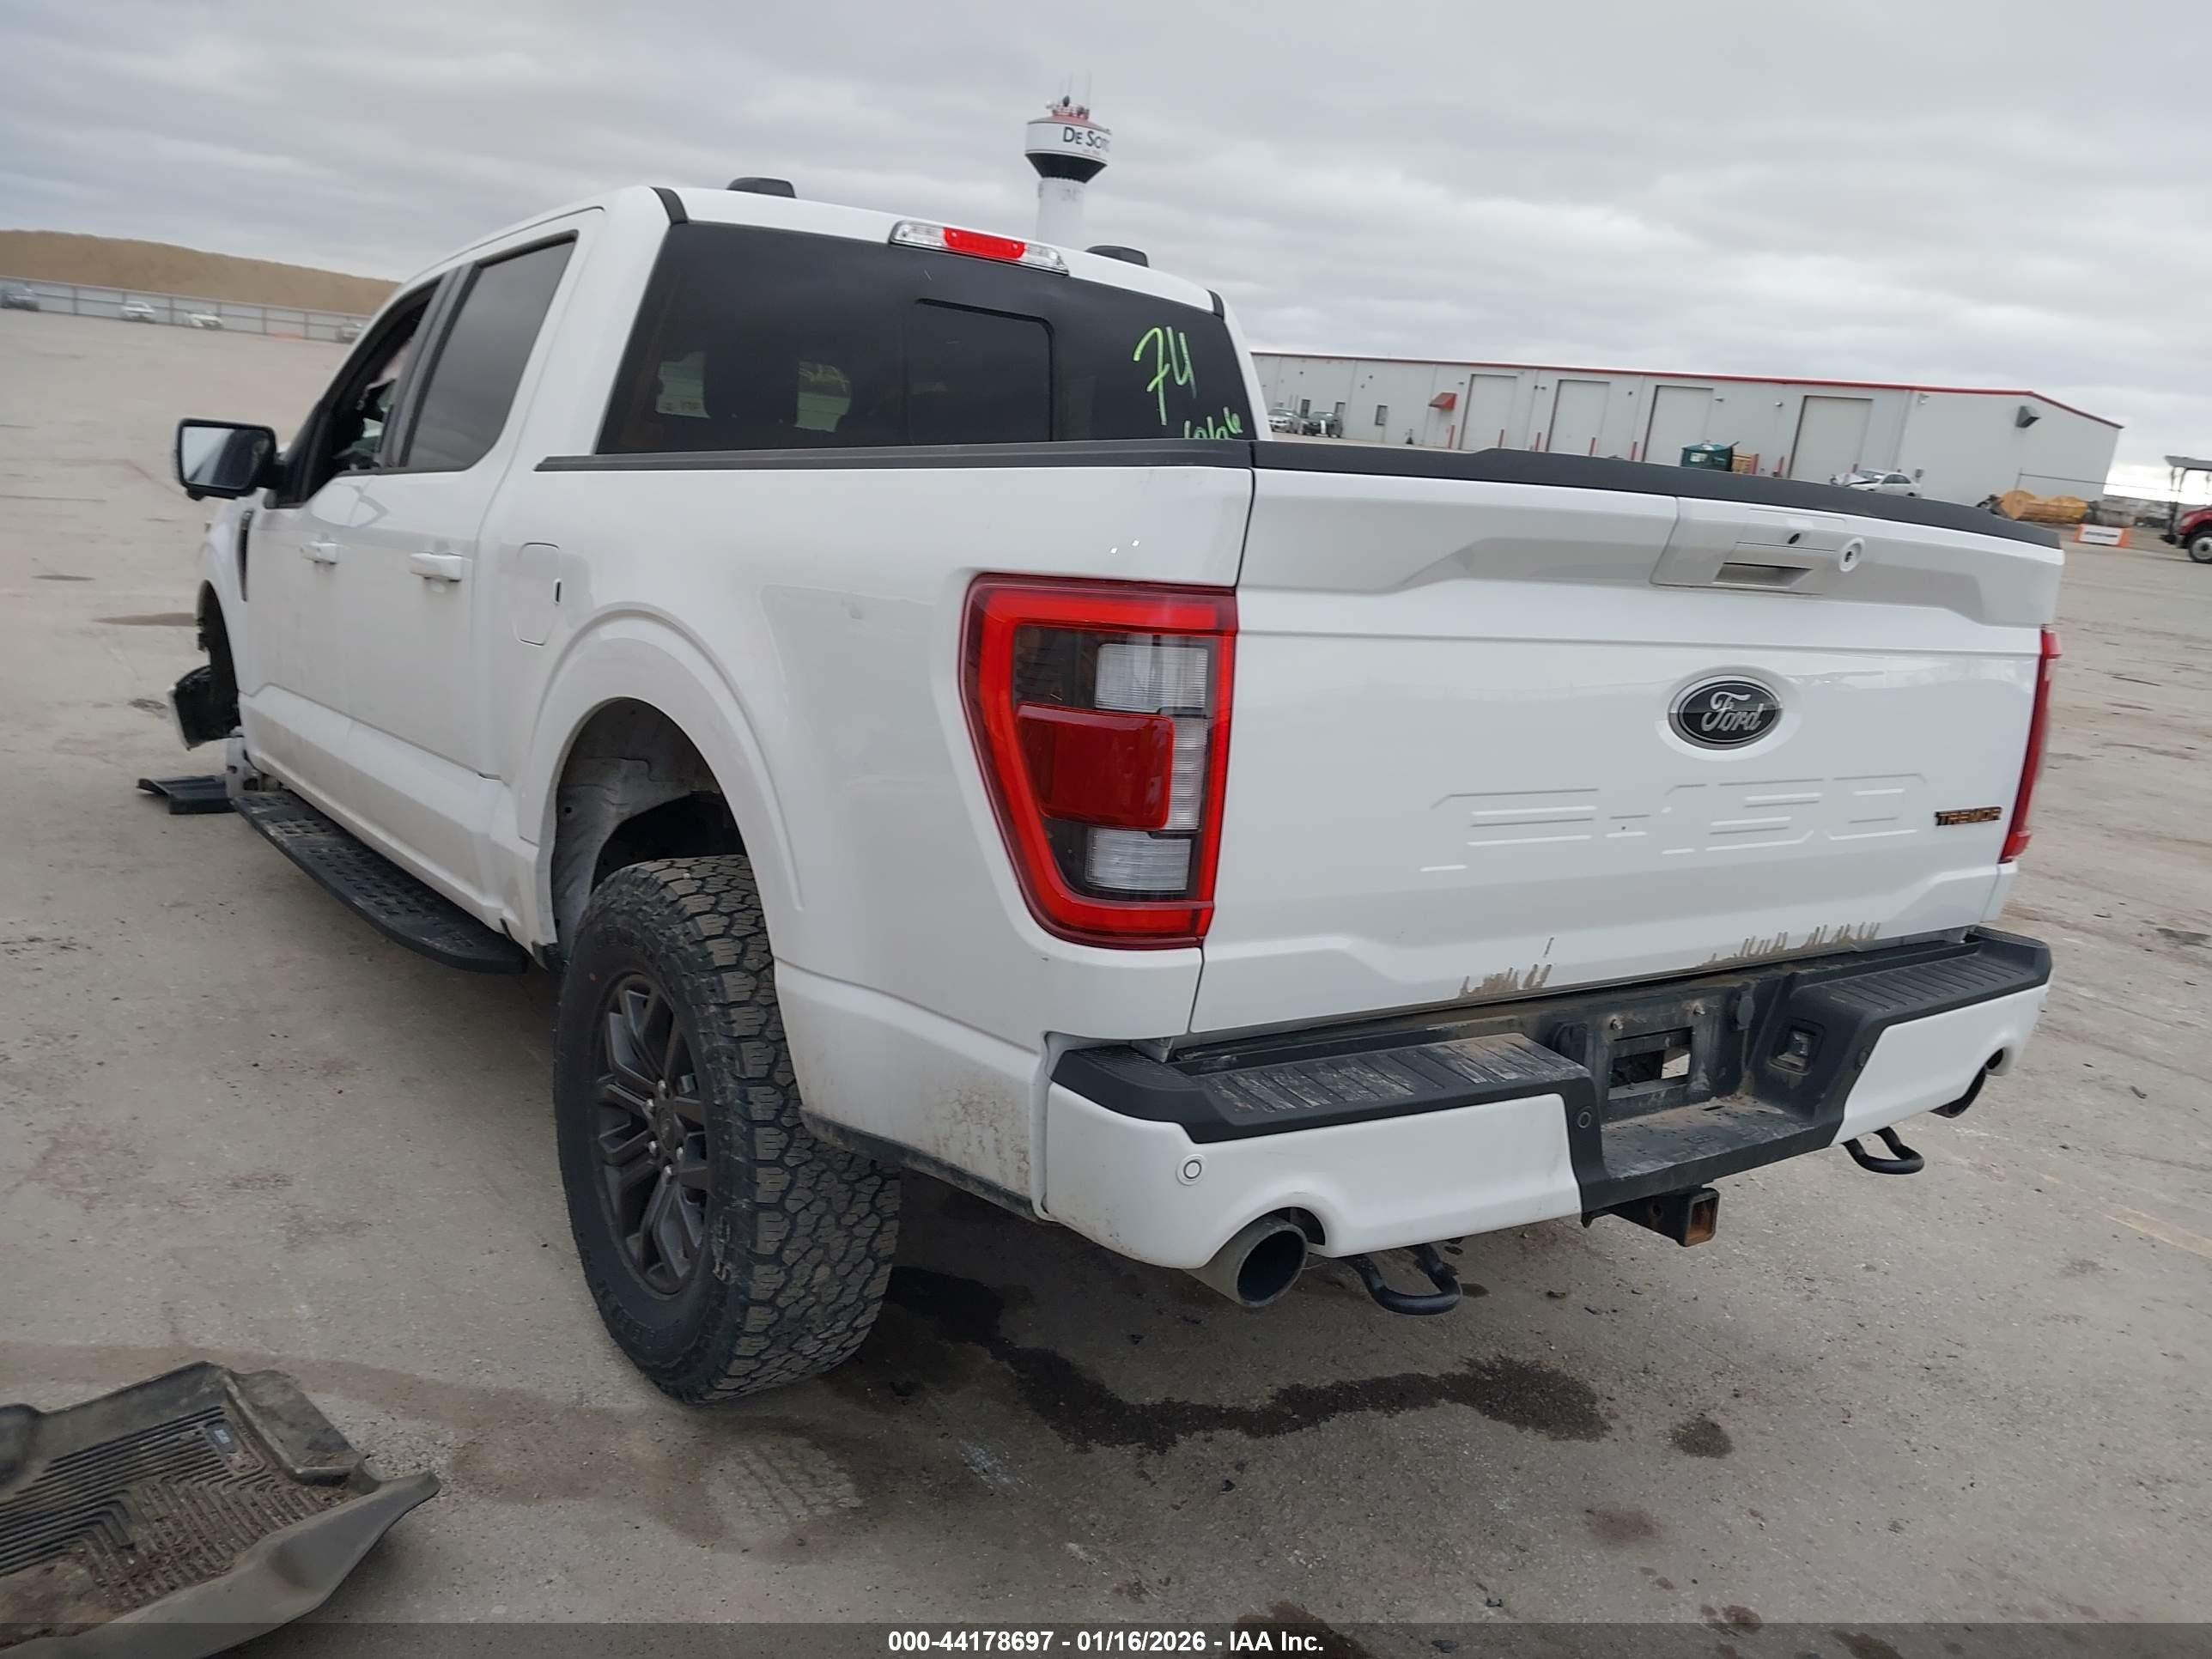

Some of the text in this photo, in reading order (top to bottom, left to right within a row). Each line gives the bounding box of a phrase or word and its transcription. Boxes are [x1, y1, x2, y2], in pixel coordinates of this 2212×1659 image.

[1133, 325, 1197, 426] 74
[1701, 690, 1764, 732] Ford
[1934, 806, 2002, 826] TREMOR
